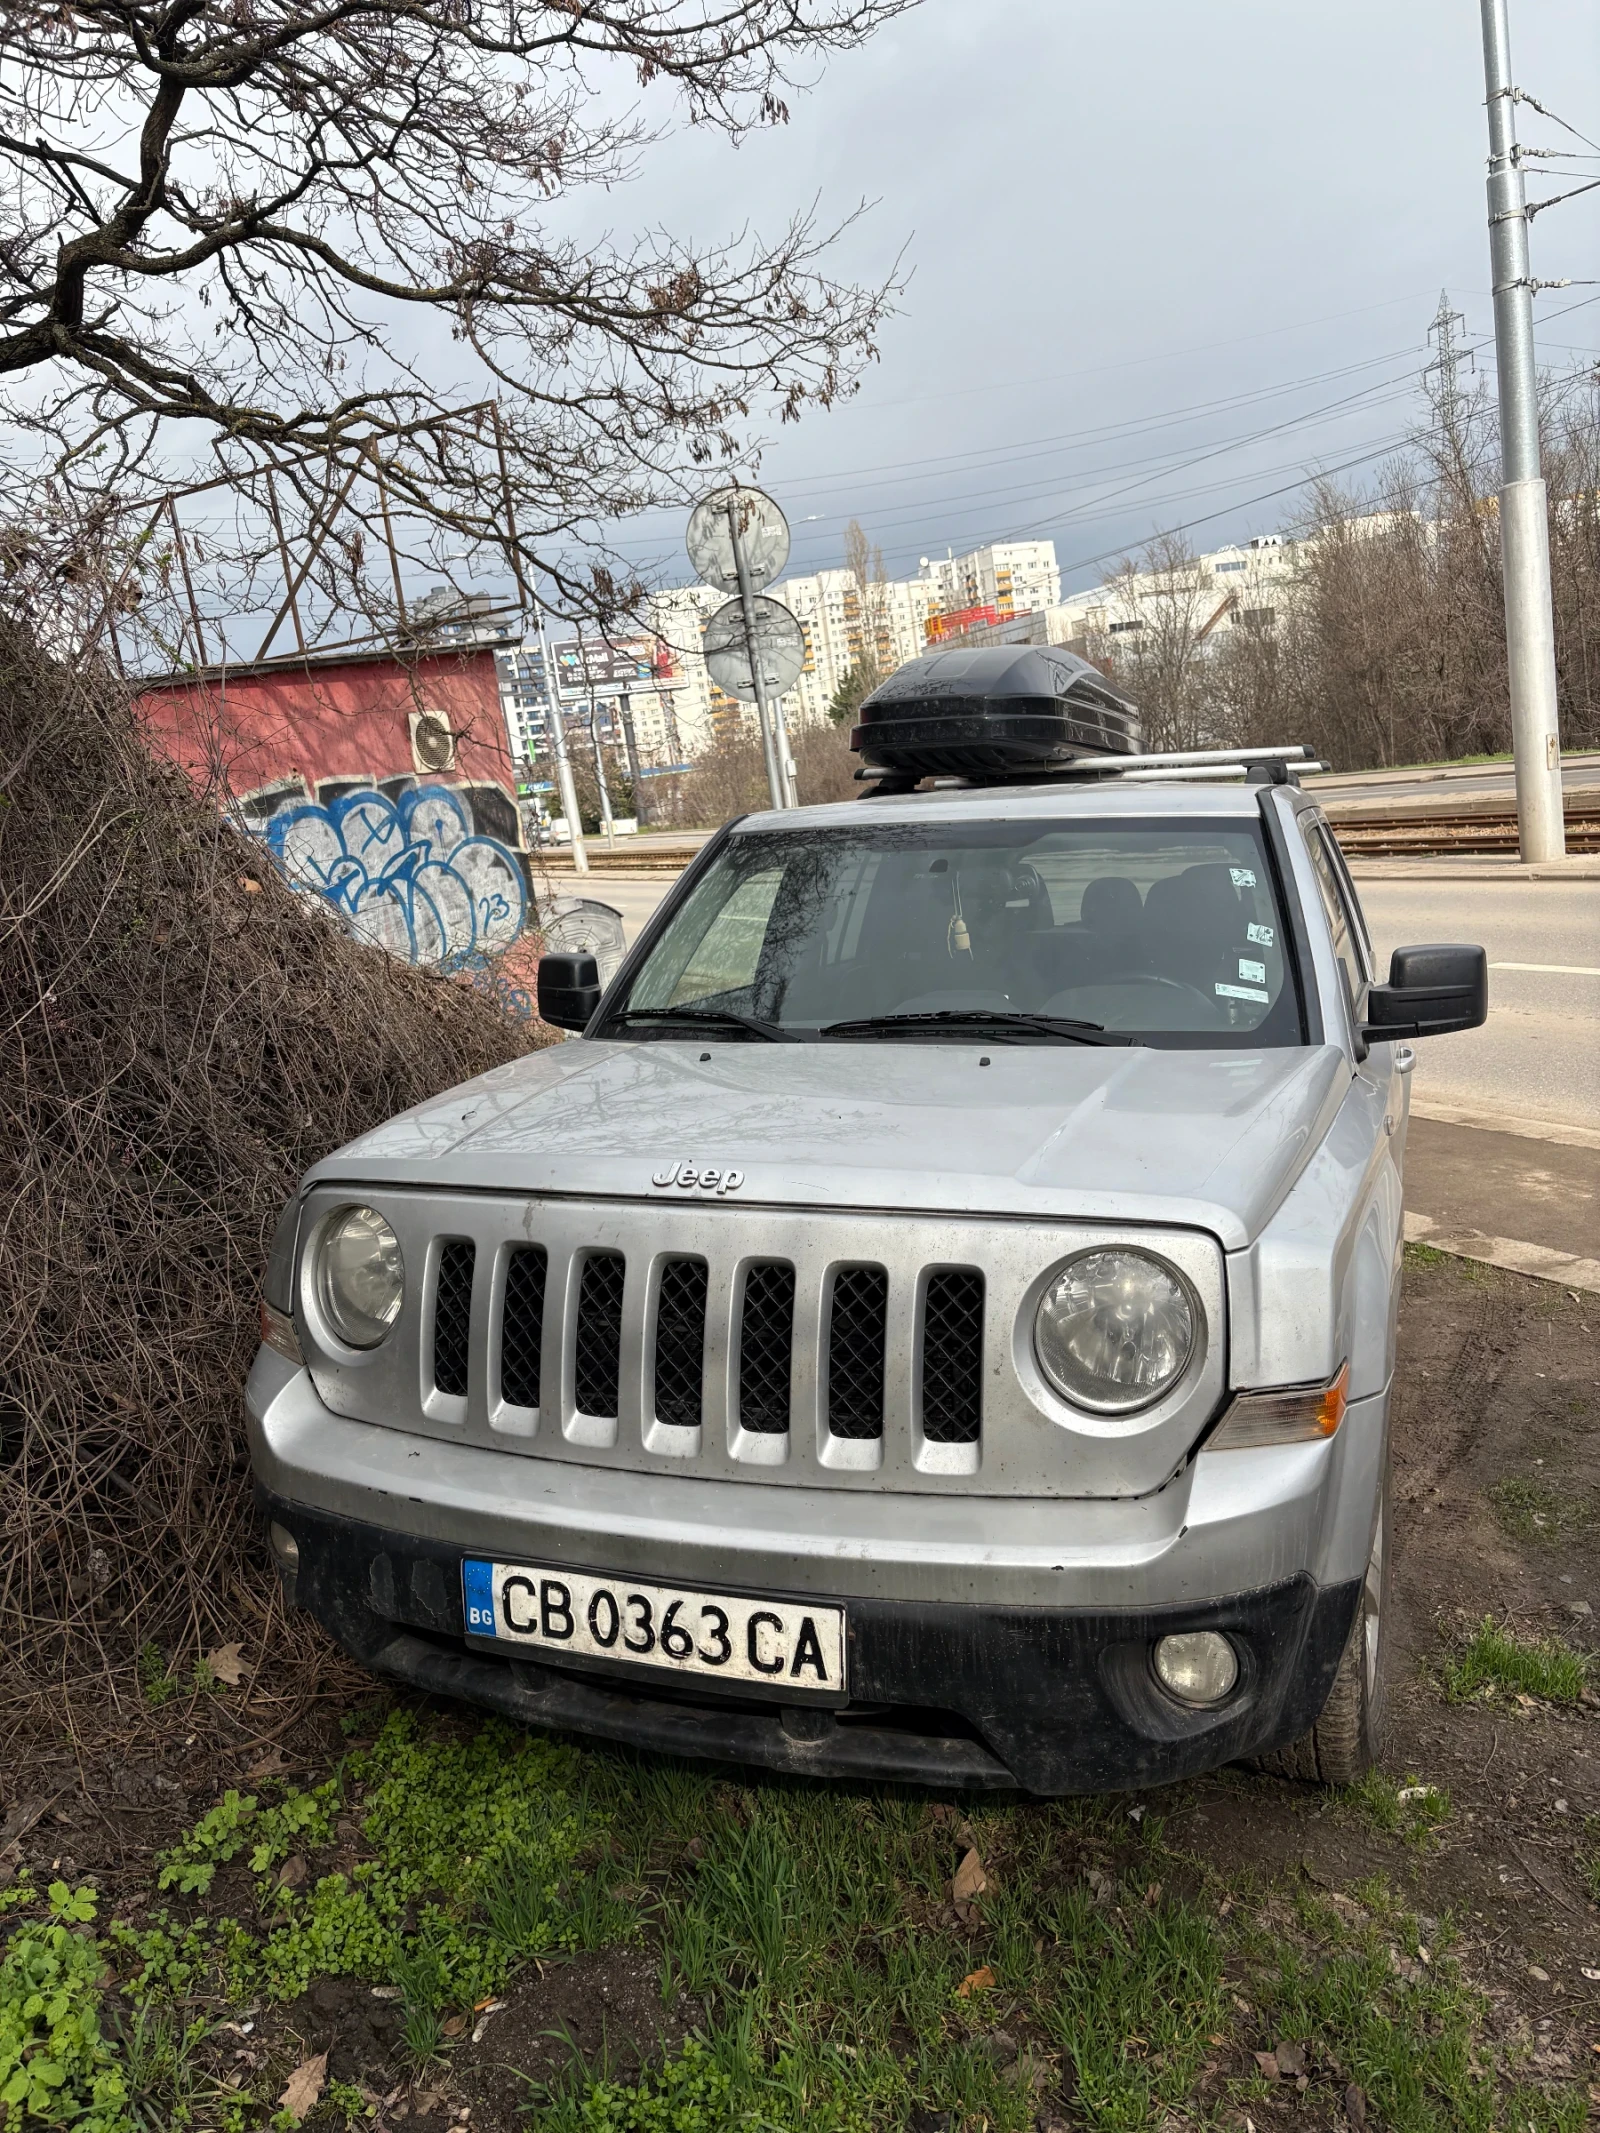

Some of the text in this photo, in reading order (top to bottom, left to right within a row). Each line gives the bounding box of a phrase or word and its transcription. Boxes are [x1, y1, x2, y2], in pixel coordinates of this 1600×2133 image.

[479, 893, 510, 936] 23
[652, 1161, 745, 1195] Jeep
[469, 1607, 493, 1627] BG
[502, 1575, 829, 1681] CB 0363 CA
